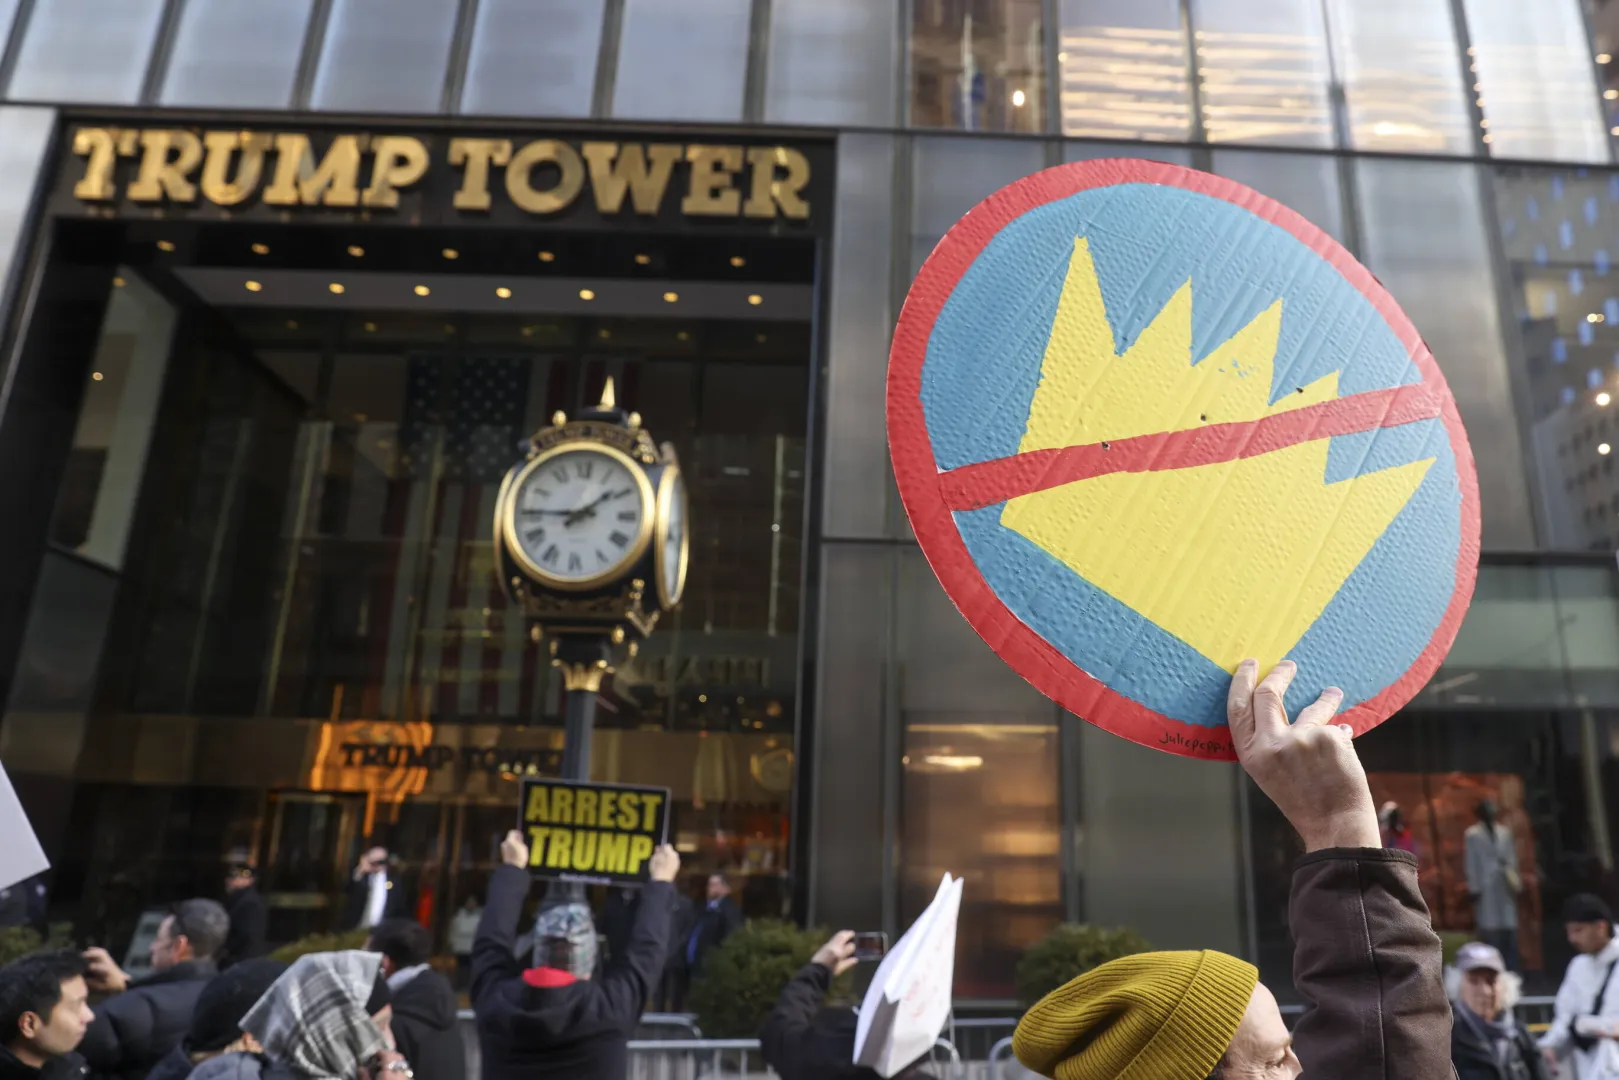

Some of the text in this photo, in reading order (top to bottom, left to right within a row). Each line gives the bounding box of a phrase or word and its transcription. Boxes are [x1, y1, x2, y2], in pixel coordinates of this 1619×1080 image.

[72, 126, 812, 219] TRUMP TOWER
[525, 785, 662, 832] ARREST
[528, 826, 654, 875] TRUMP
